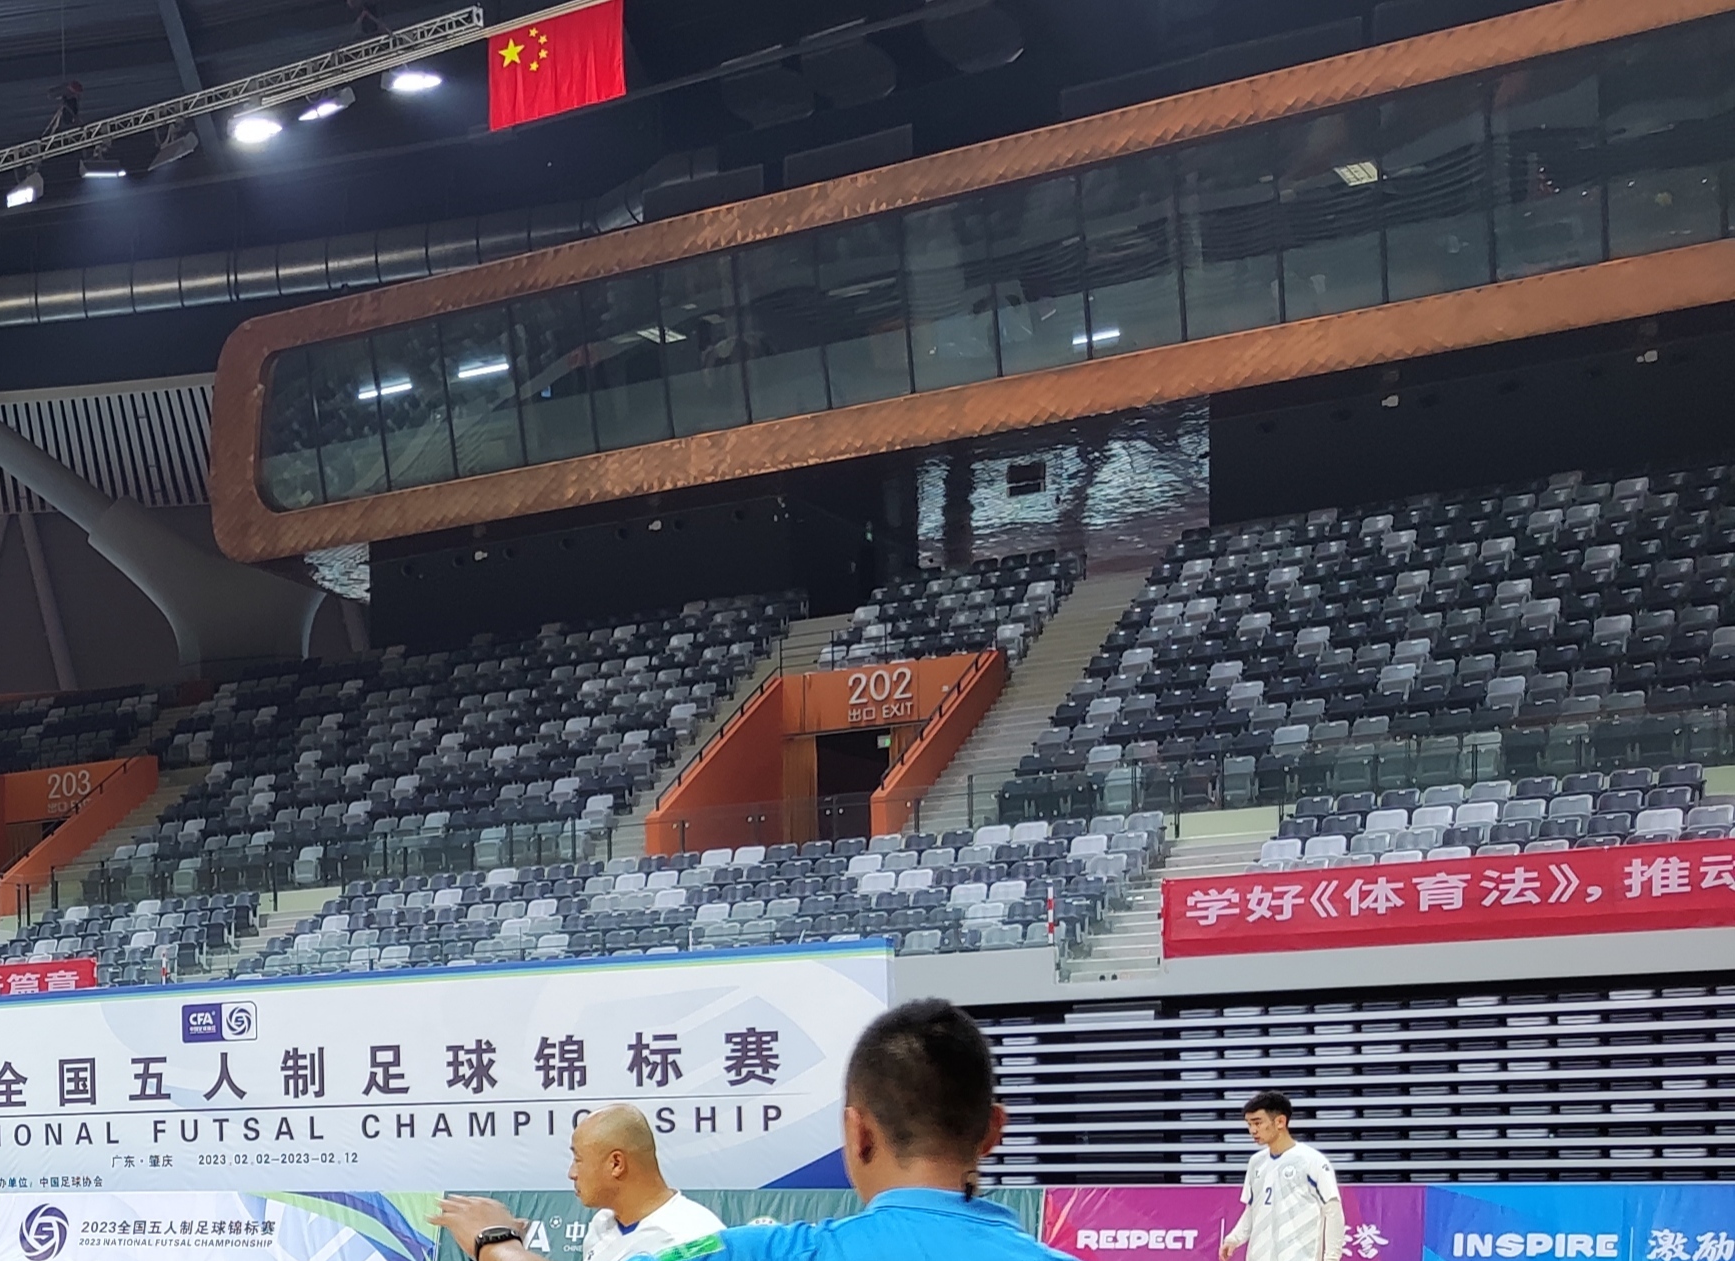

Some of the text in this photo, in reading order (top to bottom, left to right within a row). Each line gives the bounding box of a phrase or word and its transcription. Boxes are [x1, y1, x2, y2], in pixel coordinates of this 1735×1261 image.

[848, 667, 912, 705] 202
[848, 702, 913, 722] 出口 EXIT
[47, 769, 91, 799] 203
[189, 1011, 213, 1026] CFA
[152, 1115, 324, 1143] FUTSAL
[361, 1104, 783, 1139] CHAMPISHIP
[1265, 1187, 1272, 1205] 2
[81, 1220, 276, 1236] 2023全国五人制足球锦标赛
[79, 1238, 273, 1248] 2023 NATIONAL FUTSAL CHAMPIONSHIP
[1076, 1229, 1198, 1250] RESPECT
[1453, 1232, 1618, 1258] INSPIRE
